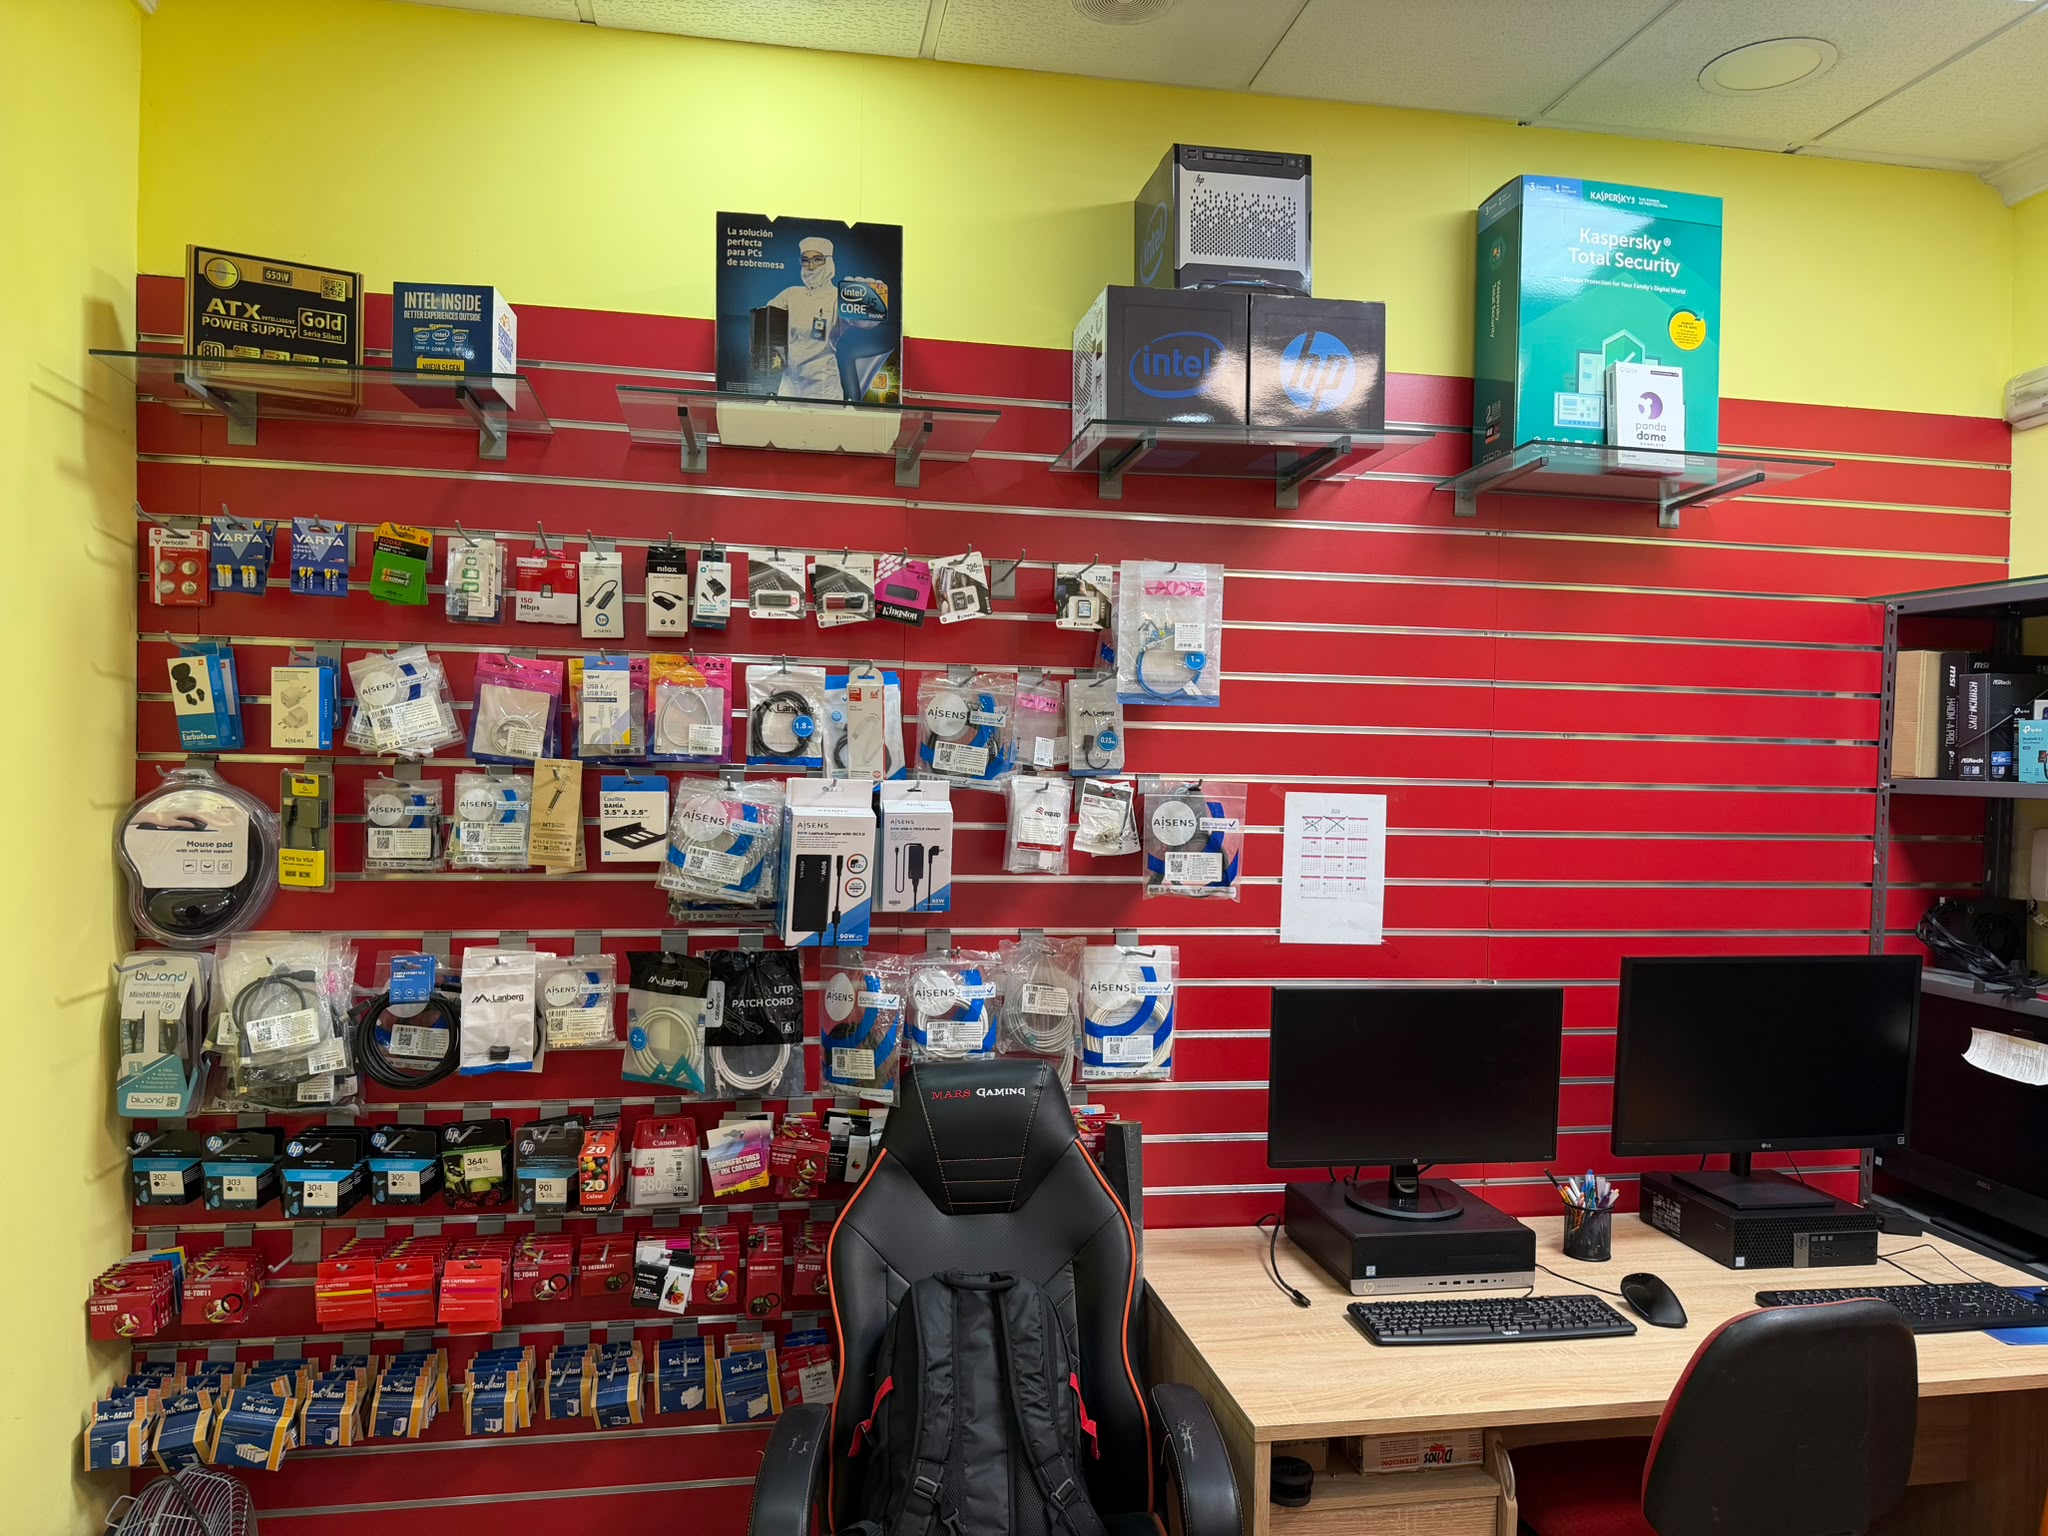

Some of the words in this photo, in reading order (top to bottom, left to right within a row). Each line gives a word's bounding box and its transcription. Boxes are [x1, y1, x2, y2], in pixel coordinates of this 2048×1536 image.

[726, 227, 737, 236] La
[739, 228, 774, 239] solución
[727, 238, 763, 248] perfecta
[727, 248, 746, 258] para
[747, 249, 763, 258] PCs
[726, 258, 738, 267] de
[739, 259, 785, 270] sobremesa
[1567, 247, 1612, 267] Total
[1615, 252, 1681, 278] Security
[265, 269, 290, 283] 650W
[1584, 278, 1612, 287] Protection
[1620, 281, 1633, 289] Your
[1633, 283, 1654, 292] Family's
[1654, 285, 1671, 294] Digital
[842, 287, 865, 298] intel
[404, 291, 438, 311] INTEL
[441, 293, 482, 312] INSIDE
[206, 297, 262, 320] ATX
[840, 303, 868, 315] CORE
[300, 311, 343, 332] Gold
[403, 310, 425, 320] BETTER
[424, 310, 459, 322] EXPERIENCES
[458, 313, 482, 322] OUTSIDE
[201, 316, 250, 333] POWER
[250, 323, 299, 340] SUPPLY
[302, 329, 321, 340] Serie
[322, 331, 343, 342] Silent
[1142, 343, 1212, 379] intel
[1635, 421, 1667, 433] panda
[1635, 431, 1667, 443] dome
[212, 532, 264, 544] VARTA
[293, 533, 345, 548] VARTA
[656, 564, 679, 574] nilox
[520, 596, 534, 605] 150
[520, 604, 541, 612] Mbps
[881, 605, 918, 622] Kingston
[1973, 661, 1991, 670] msi
[1949, 664, 1957, 688] msi
[599, 690, 613, 698] Tipo
[794, 722, 807, 730] 1.8
[182, 733, 208, 742] Earbuds
[1960, 757, 1984, 765] ASRock
[1043, 809, 1062, 820] equip
[186, 840, 215, 848] Mouse
[216, 841, 233, 849] pad
[302, 856, 315, 864] VGA
[134, 969, 188, 984] biwond
[661, 976, 689, 989] Lanberg
[129, 991, 183, 999] MiniHDMI-HDMI
[773, 985, 794, 995] UTP
[492, 992, 525, 1004] Lanberg
[731, 999, 764, 1009] PATCH
[764, 997, 795, 1007] CORD
[130, 1095, 165, 1104] biwond
[931, 1089, 972, 1101] MARS
[975, 1087, 1026, 1098] GAMING
[586, 1146, 607, 1154] 20
[466, 1157, 483, 1166] 364
[644, 1167, 654, 1175] XL
[720, 1166, 732, 1175] INK
[731, 1161, 762, 1173] CARTRIDGE
[153, 1173, 168, 1181] 302
[226, 1178, 241, 1186] 303
[390, 1173, 405, 1181] 305
[306, 1183, 323, 1192] 304
[538, 1183, 553, 1192] 901
[584, 1179, 606, 1192] 20
[241, 1402, 278, 1415] Ink-Man
